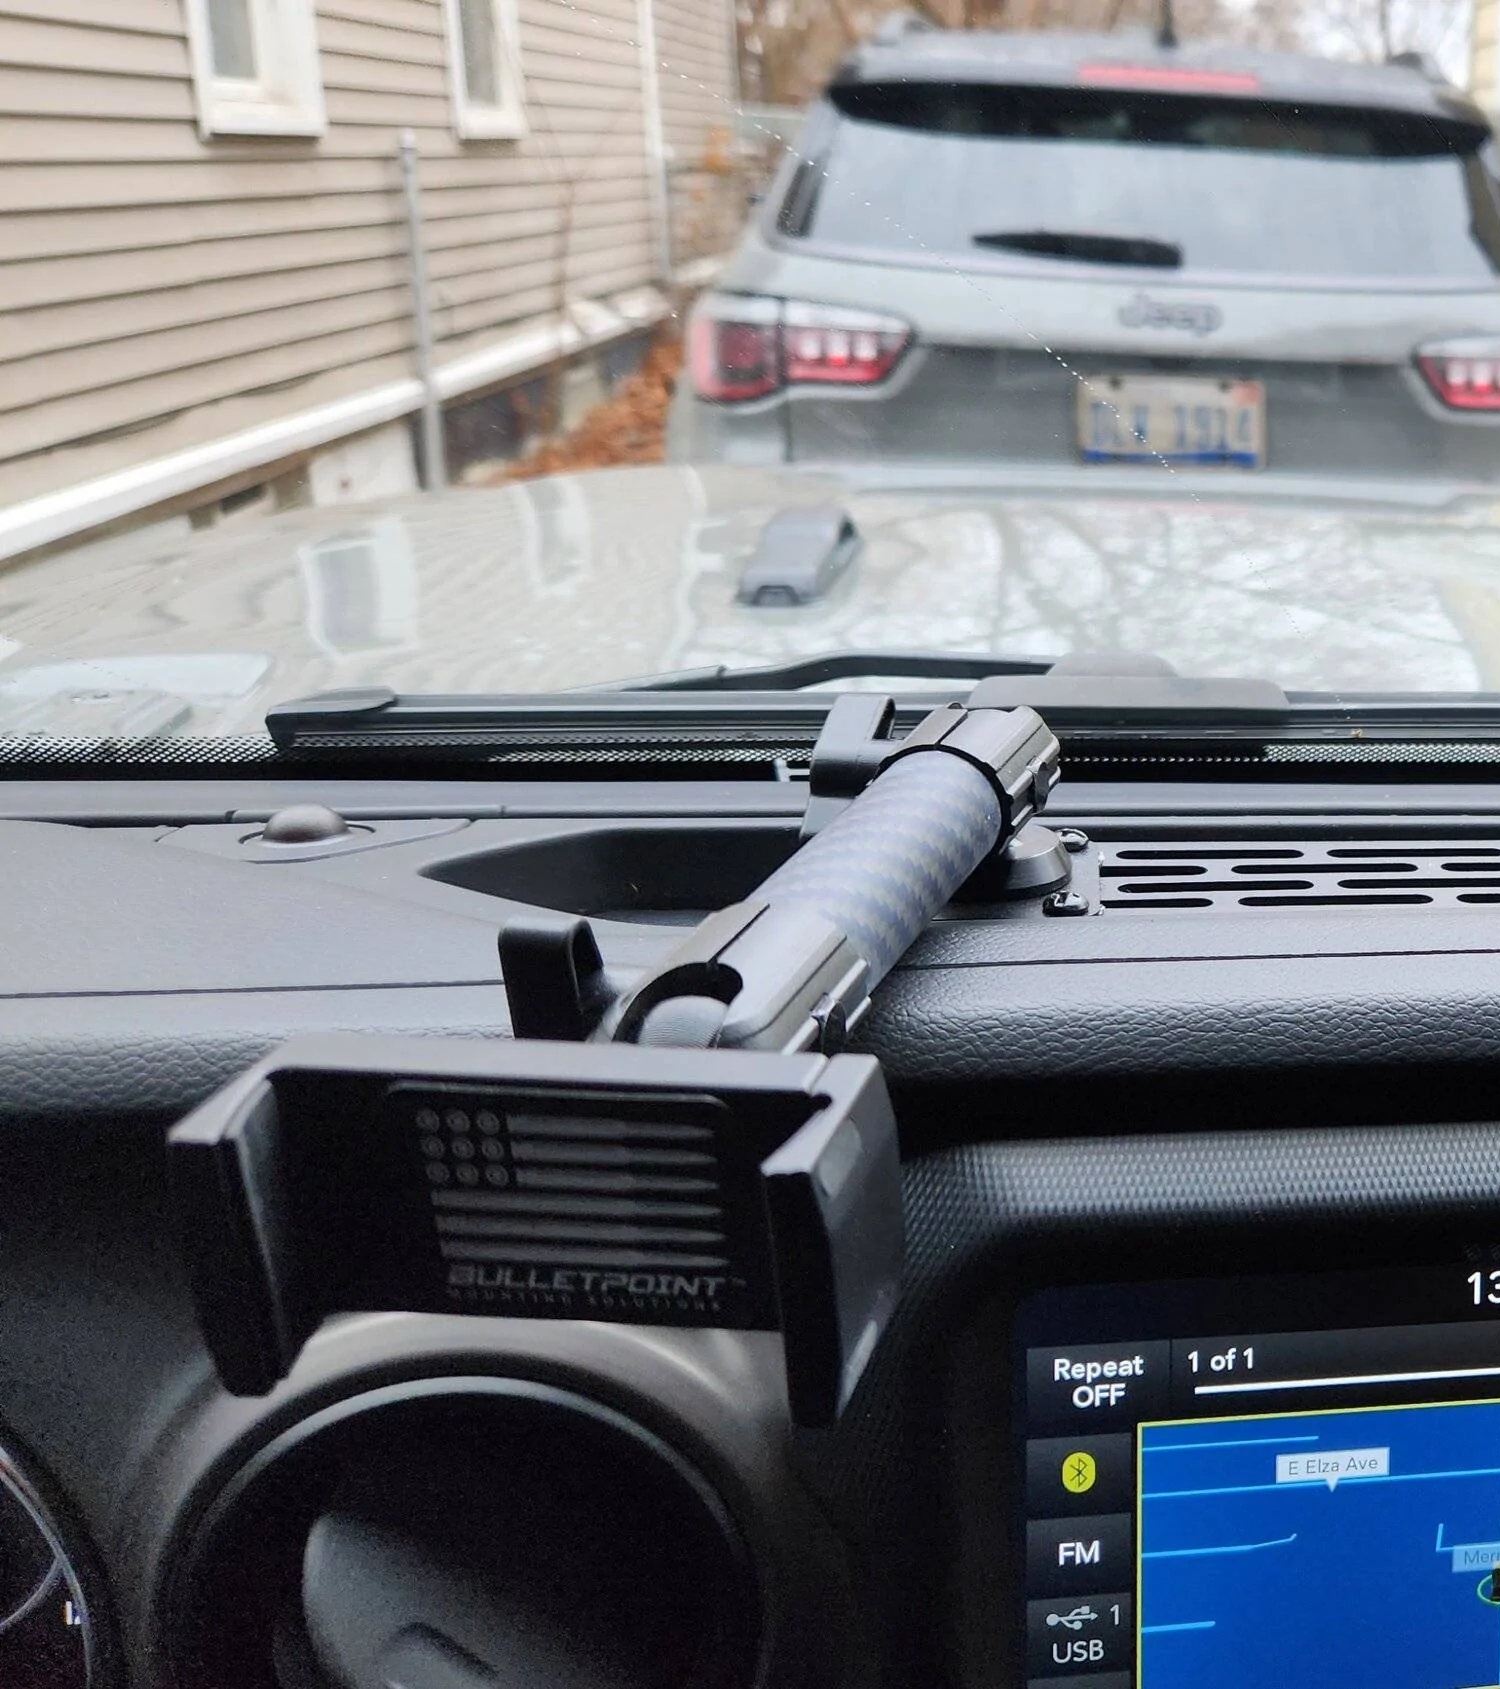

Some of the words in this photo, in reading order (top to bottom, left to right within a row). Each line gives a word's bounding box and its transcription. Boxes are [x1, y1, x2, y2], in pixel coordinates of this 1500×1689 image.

[1118, 294, 1224, 338] Jeep
[449, 1264, 726, 1296] BULLETPOINT
[1053, 1355, 1145, 1383] Repeat
[1187, 1351, 1199, 1373] 1
[1210, 1347, 1237, 1371] of
[1242, 1347, 1254, 1369] 1
[1072, 1382, 1127, 1409] OFF
[1288, 1460, 1299, 1476] E
[1306, 1459, 1340, 1474] Elza
[1346, 1456, 1378, 1471] Ave
[1057, 1540, 1100, 1566] FM
[1110, 1604, 1121, 1627] 1
[1052, 1639, 1105, 1664] USB
